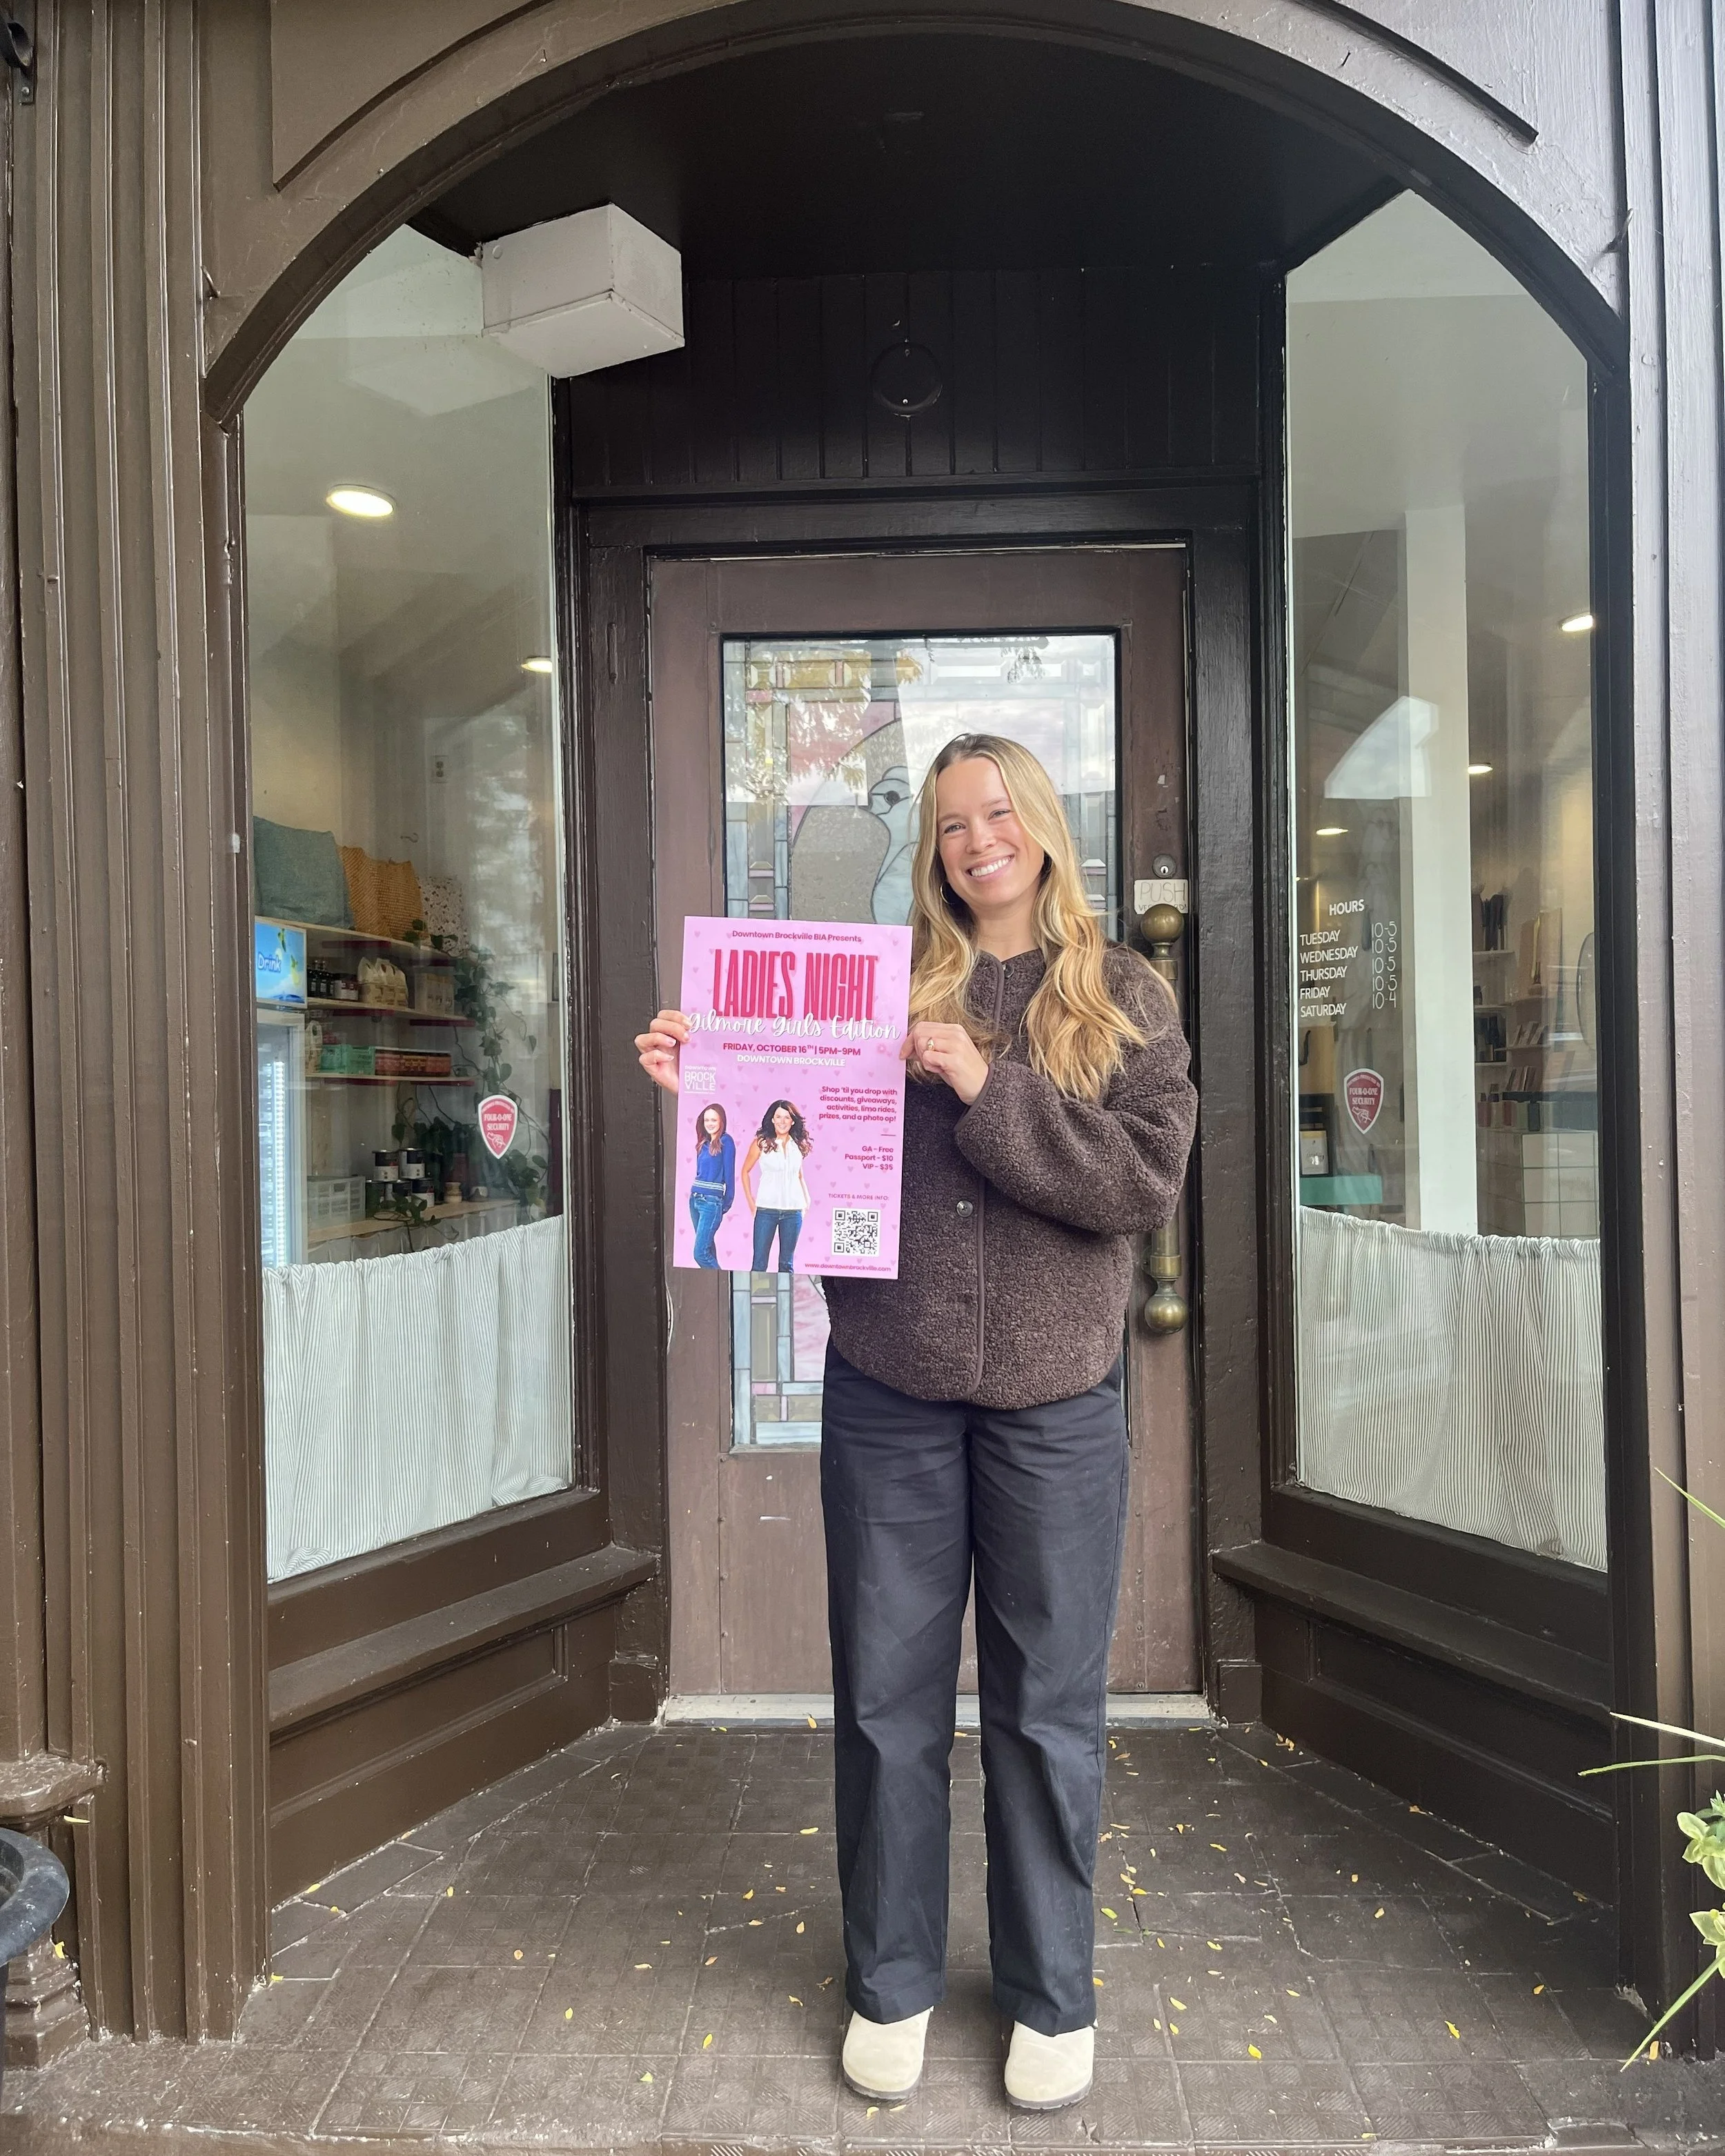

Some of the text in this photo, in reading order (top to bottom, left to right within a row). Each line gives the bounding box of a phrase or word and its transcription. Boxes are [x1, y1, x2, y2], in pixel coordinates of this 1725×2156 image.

[1140, 882, 1185, 903] PUSH
[1329, 899, 1365, 916] HOURS
[732, 930, 773, 938] Downtown
[775, 931, 813, 940] Brockville
[828, 934, 862, 942] Presents
[1300, 921, 1397, 946] TUESDAY 10-5
[1300, 937, 1397, 964] WEDNESDAY 10-5
[257, 951, 282, 973] Drink
[1300, 956, 1396, 982] THURSDAY 10-5
[713, 949, 878, 1021] LADIES NIGHT
[1300, 975, 1397, 1000] FRIDAY 10-5
[1301, 991, 1397, 1018] SATURDAY 10-4
[829, 1014, 901, 1041] Edition
[723, 1042, 756, 1052] FRIDAY,
[757, 1044, 797, 1054] OCTOBER
[737, 1054, 846, 1067] DOWNTOWN BROCKVILLE
[684, 1071, 716, 1084] BROCK
[684, 1080, 716, 1091] VILLE
[822, 1086, 840, 1094] Shop
[865, 1087, 881, 1096] drop
[820, 1095, 897, 1105] discounts, giveaways,
[1352, 1097, 1375, 1105] SECURITY
[826, 1104, 860, 1112] activities,
[878, 1105, 896, 1114] rides,
[819, 1112, 841, 1120] prizes,
[862, 1114, 884, 1122] photo
[486, 1122, 510, 1131] SECURITY
[845, 1154, 876, 1162] Passport
[805, 1263, 891, 1272] www.downtownbrockville.com
